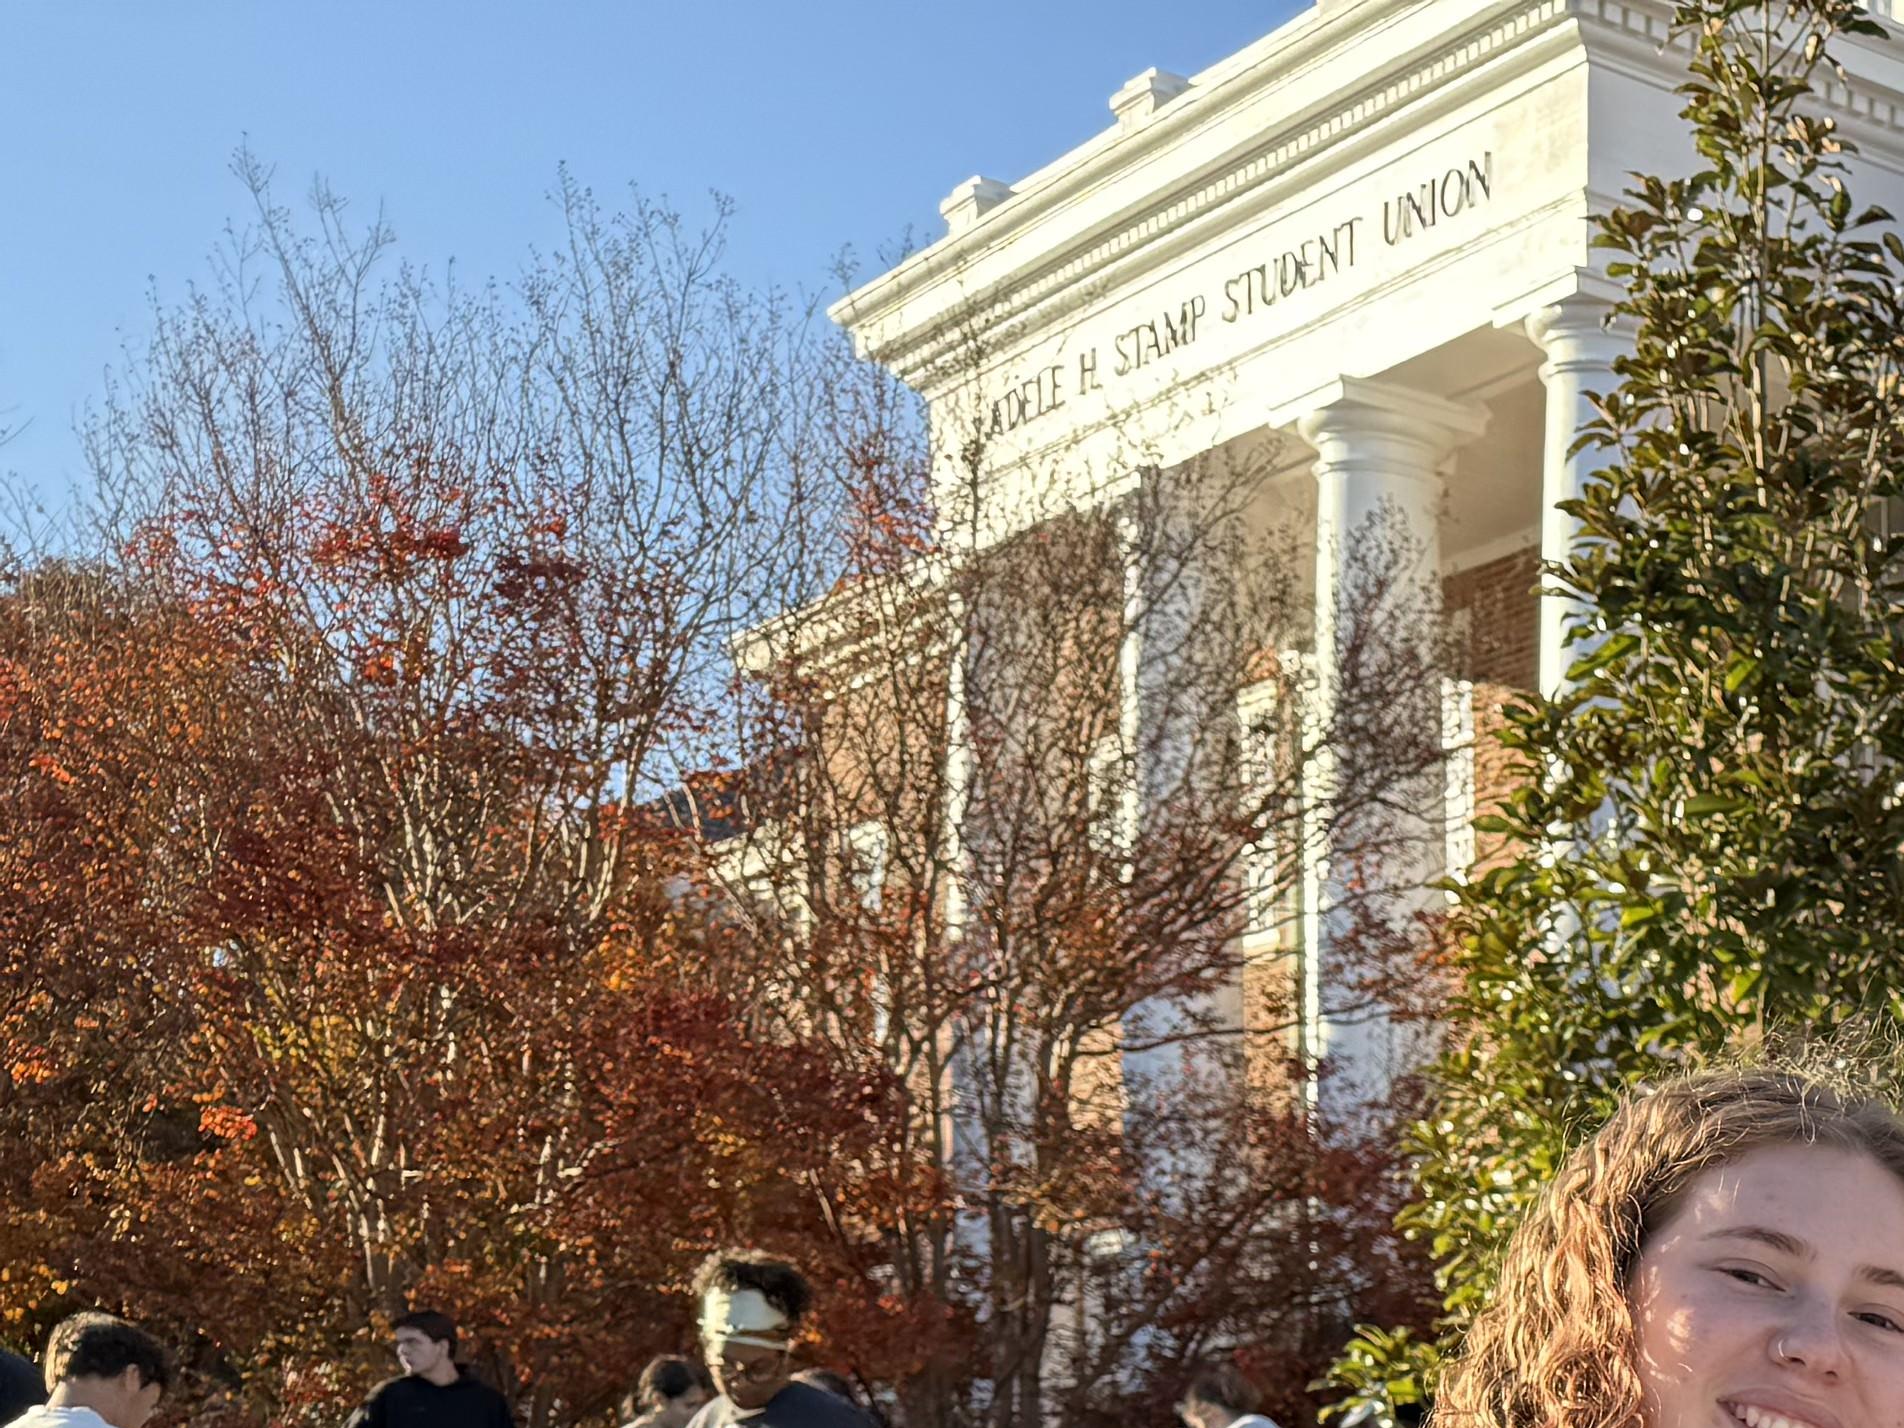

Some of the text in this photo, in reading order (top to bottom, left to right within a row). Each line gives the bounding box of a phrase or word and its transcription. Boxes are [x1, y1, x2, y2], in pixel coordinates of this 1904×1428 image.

[992, 365, 1065, 434] ADELE
[1115, 296, 1205, 375] STAMP
[1223, 217, 1362, 322] STUDENT
[1384, 152, 1491, 245] UNION
